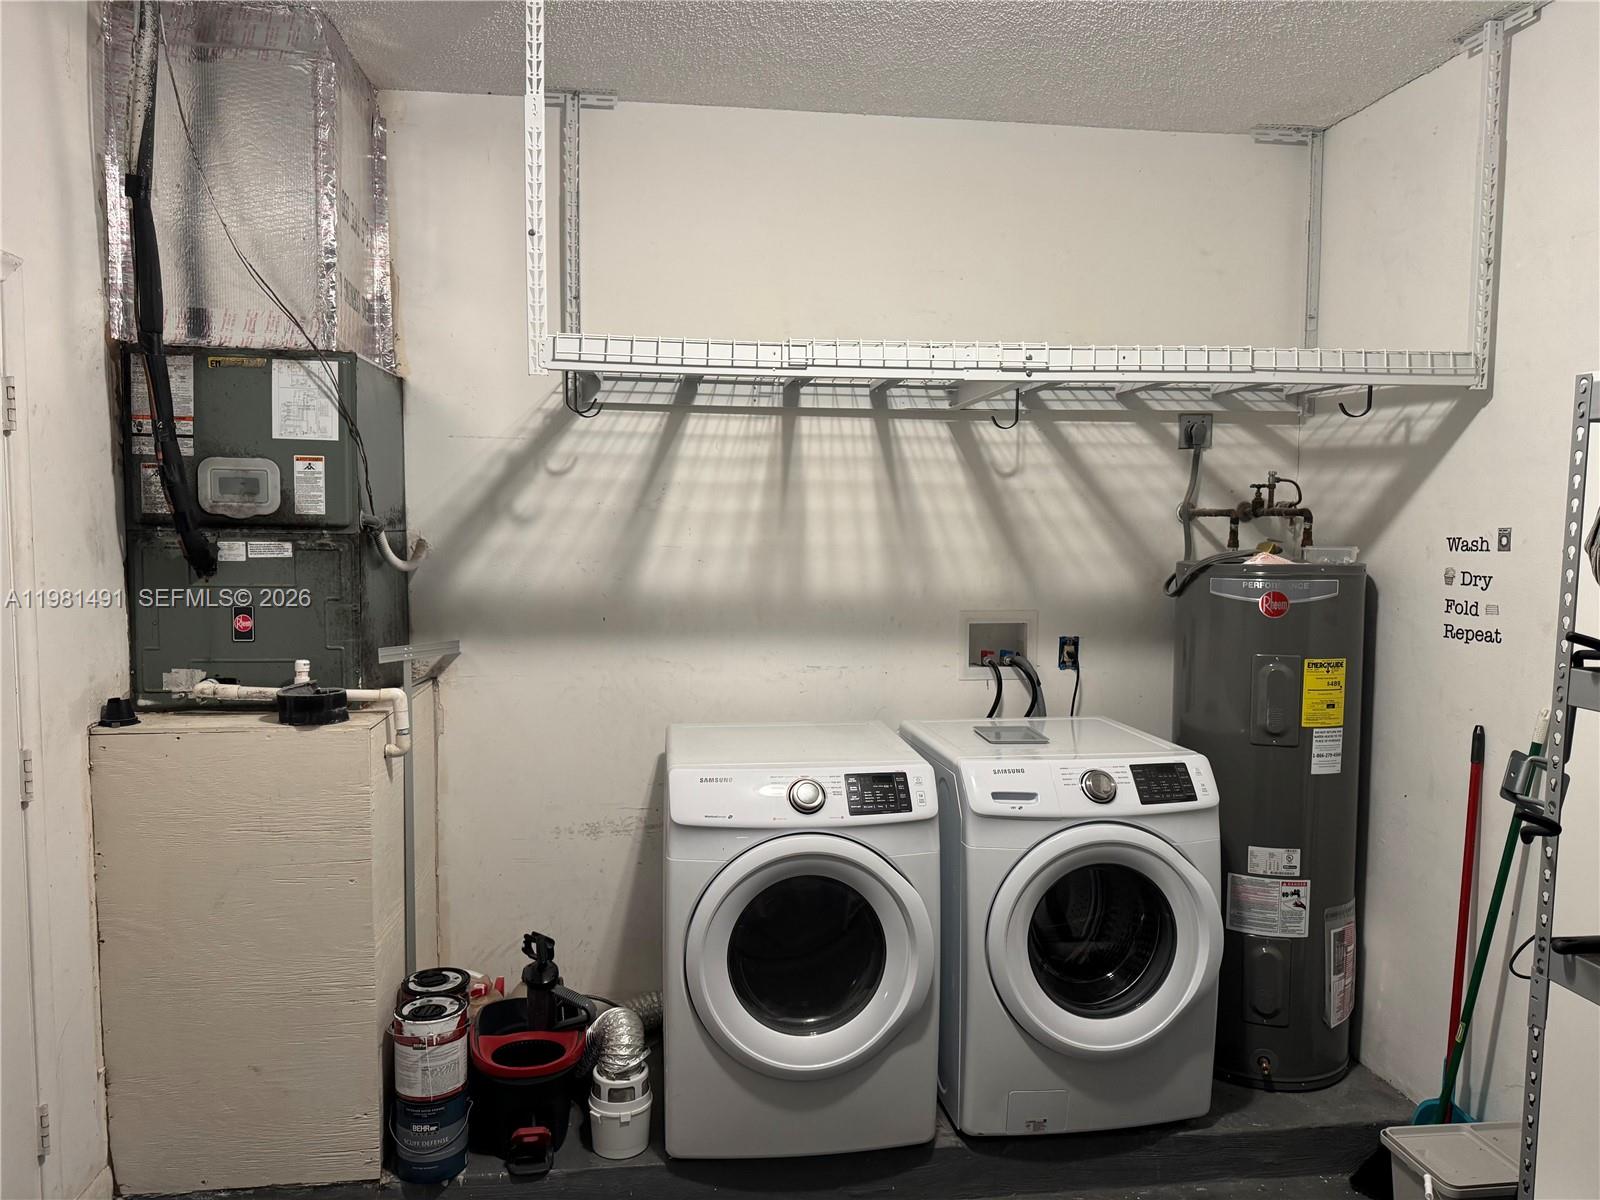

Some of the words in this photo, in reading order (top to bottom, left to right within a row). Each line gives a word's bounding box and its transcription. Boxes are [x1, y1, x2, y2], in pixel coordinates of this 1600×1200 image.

[1446, 536, 1490, 552] Wash
[1460, 571, 1493, 591] Dry
[1263, 592, 1288, 614] Rheem
[1444, 598, 1479, 617] Fold
[1443, 623, 1502, 644] Repeat
[412, 1124, 431, 1132] BEHR
